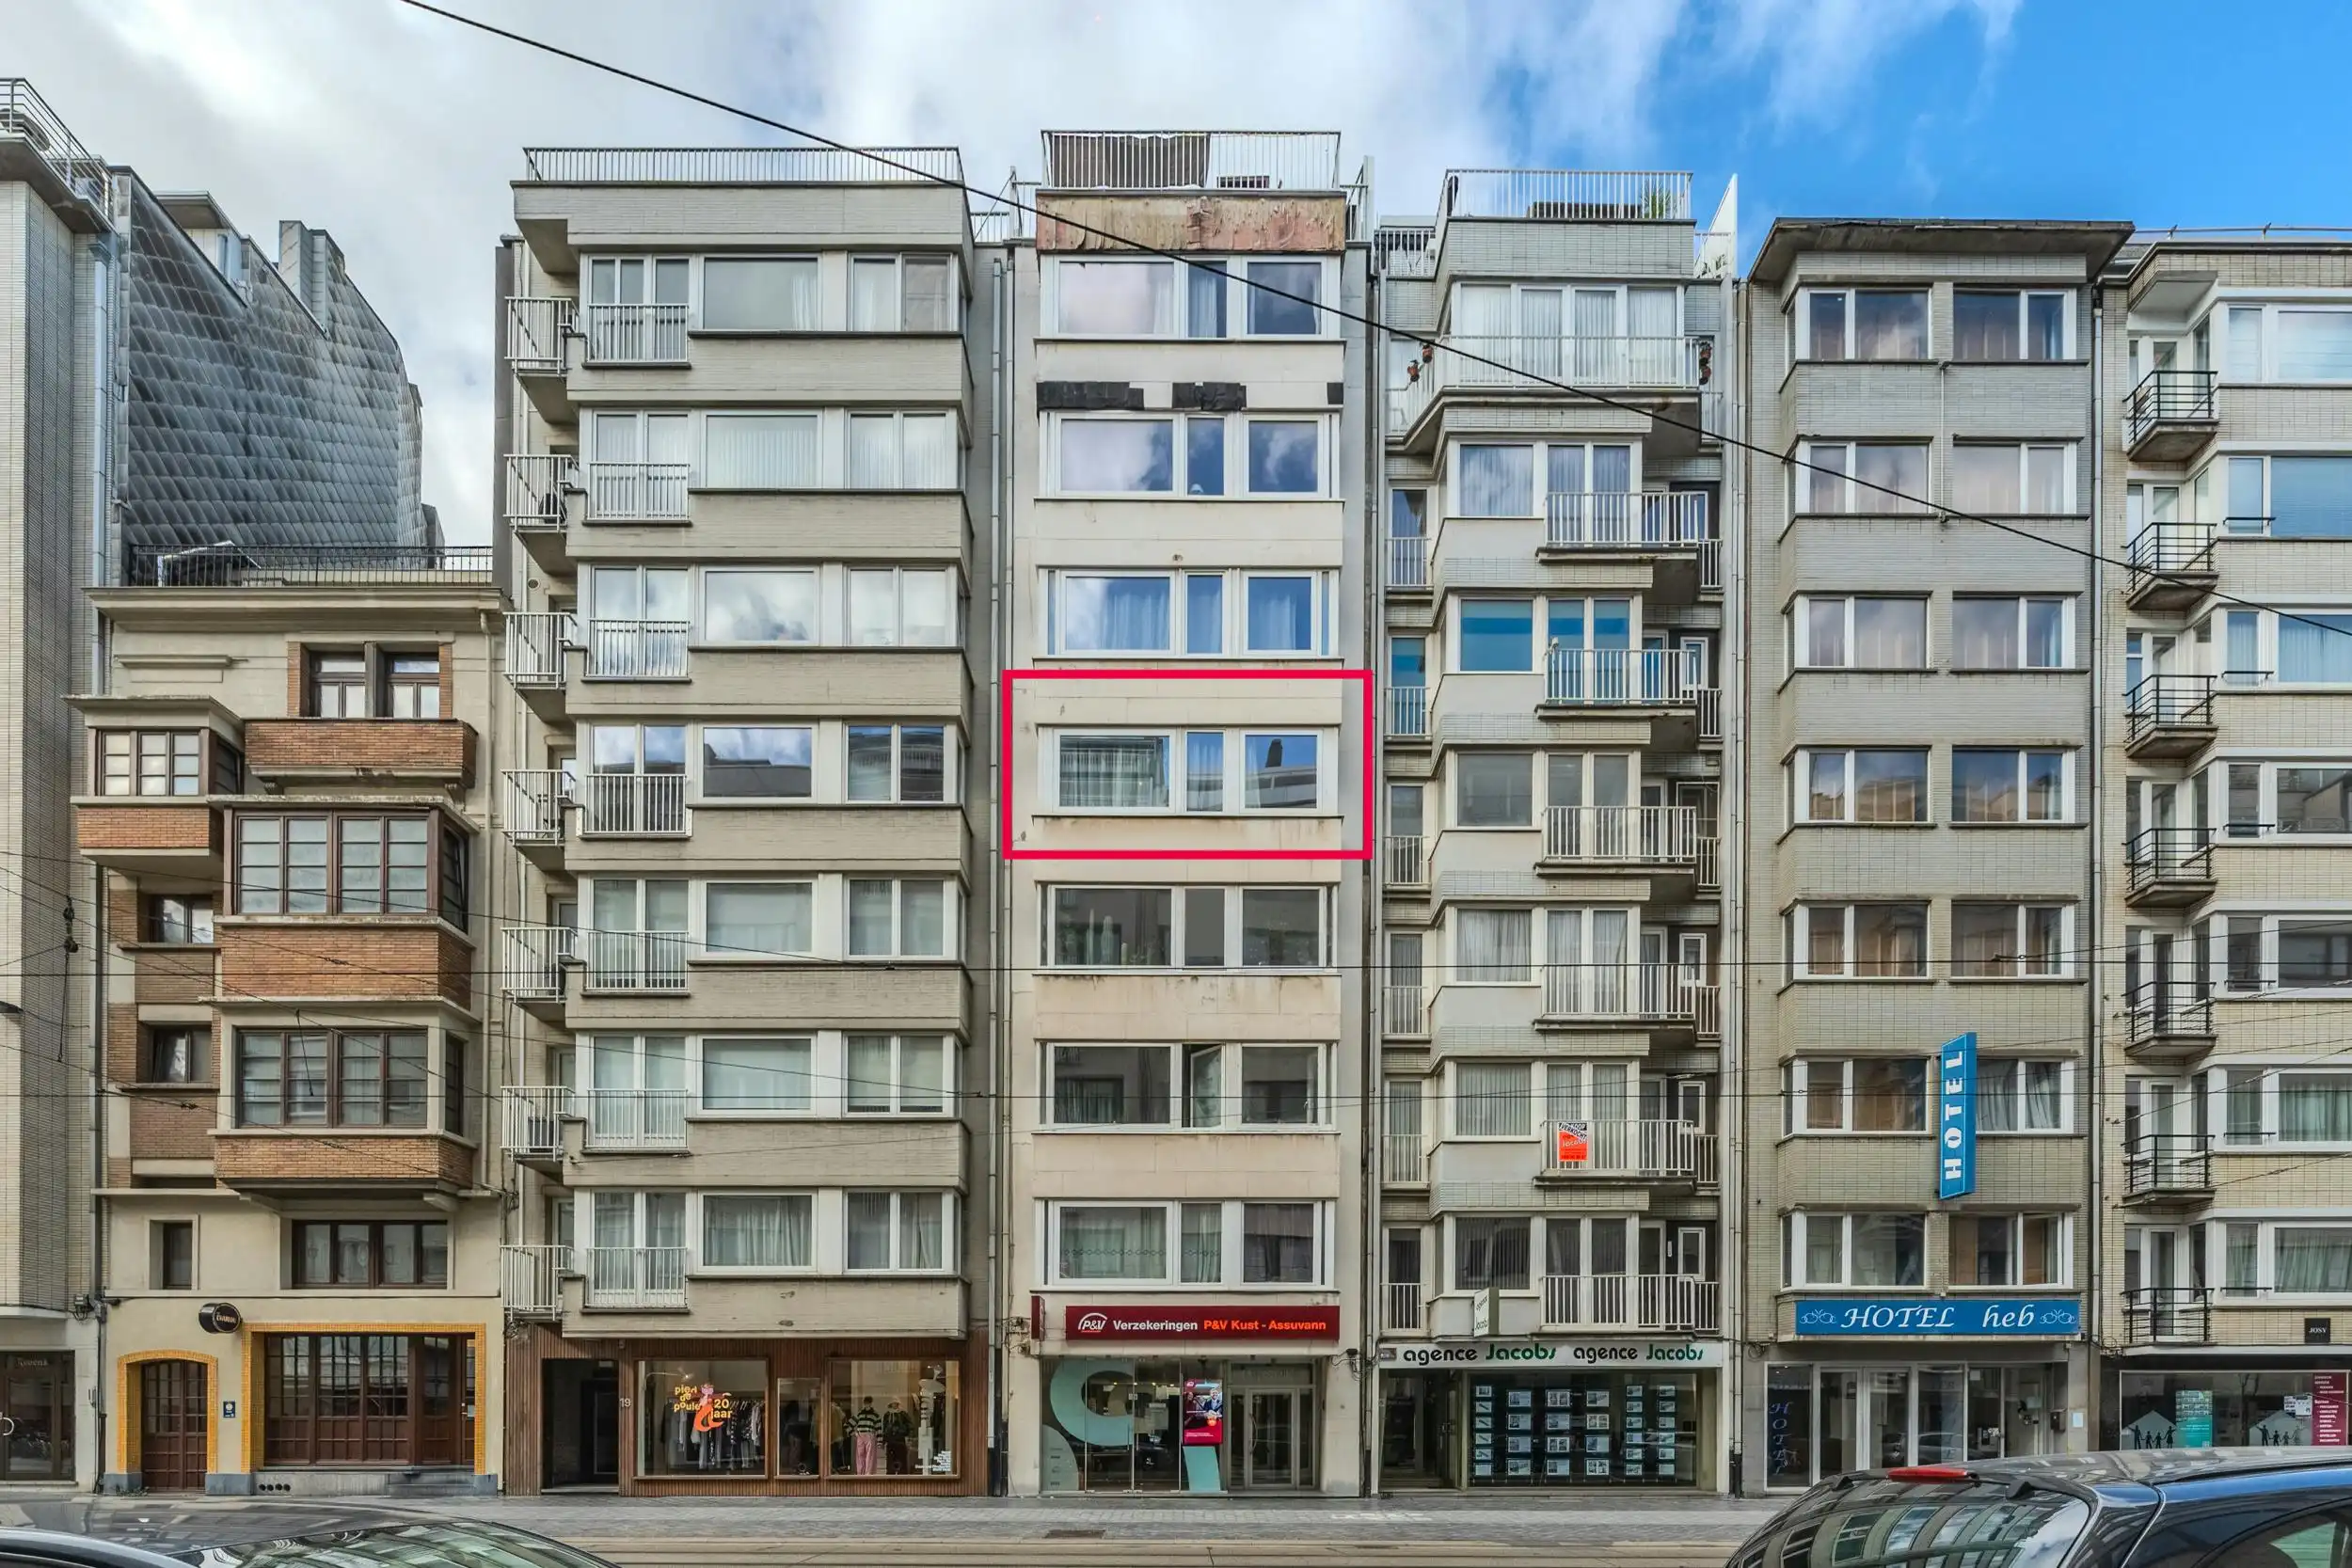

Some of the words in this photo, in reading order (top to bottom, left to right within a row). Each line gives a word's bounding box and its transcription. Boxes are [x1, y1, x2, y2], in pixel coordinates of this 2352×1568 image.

[1944, 1051, 1963, 1180] HOTEL
[1113, 1320, 1198, 1332] Verzekeringen
[1203, 1320, 1228, 1330] P&V
[1232, 1320, 1259, 1330] Kust
[1268, 1320, 1327, 1330] Assuvann
[1840, 1305, 1955, 1328] HOTEL
[1982, 1304, 2035, 1328] heb
[1403, 1348, 1478, 1365] agence
[1486, 1343, 1557, 1360] Jacobs
[1573, 1347, 1638, 1364] agence
[1646, 1343, 1704, 1360] Jacobs
[620, 1398, 632, 1408] 19
[714, 1399, 729, 1409] 20
